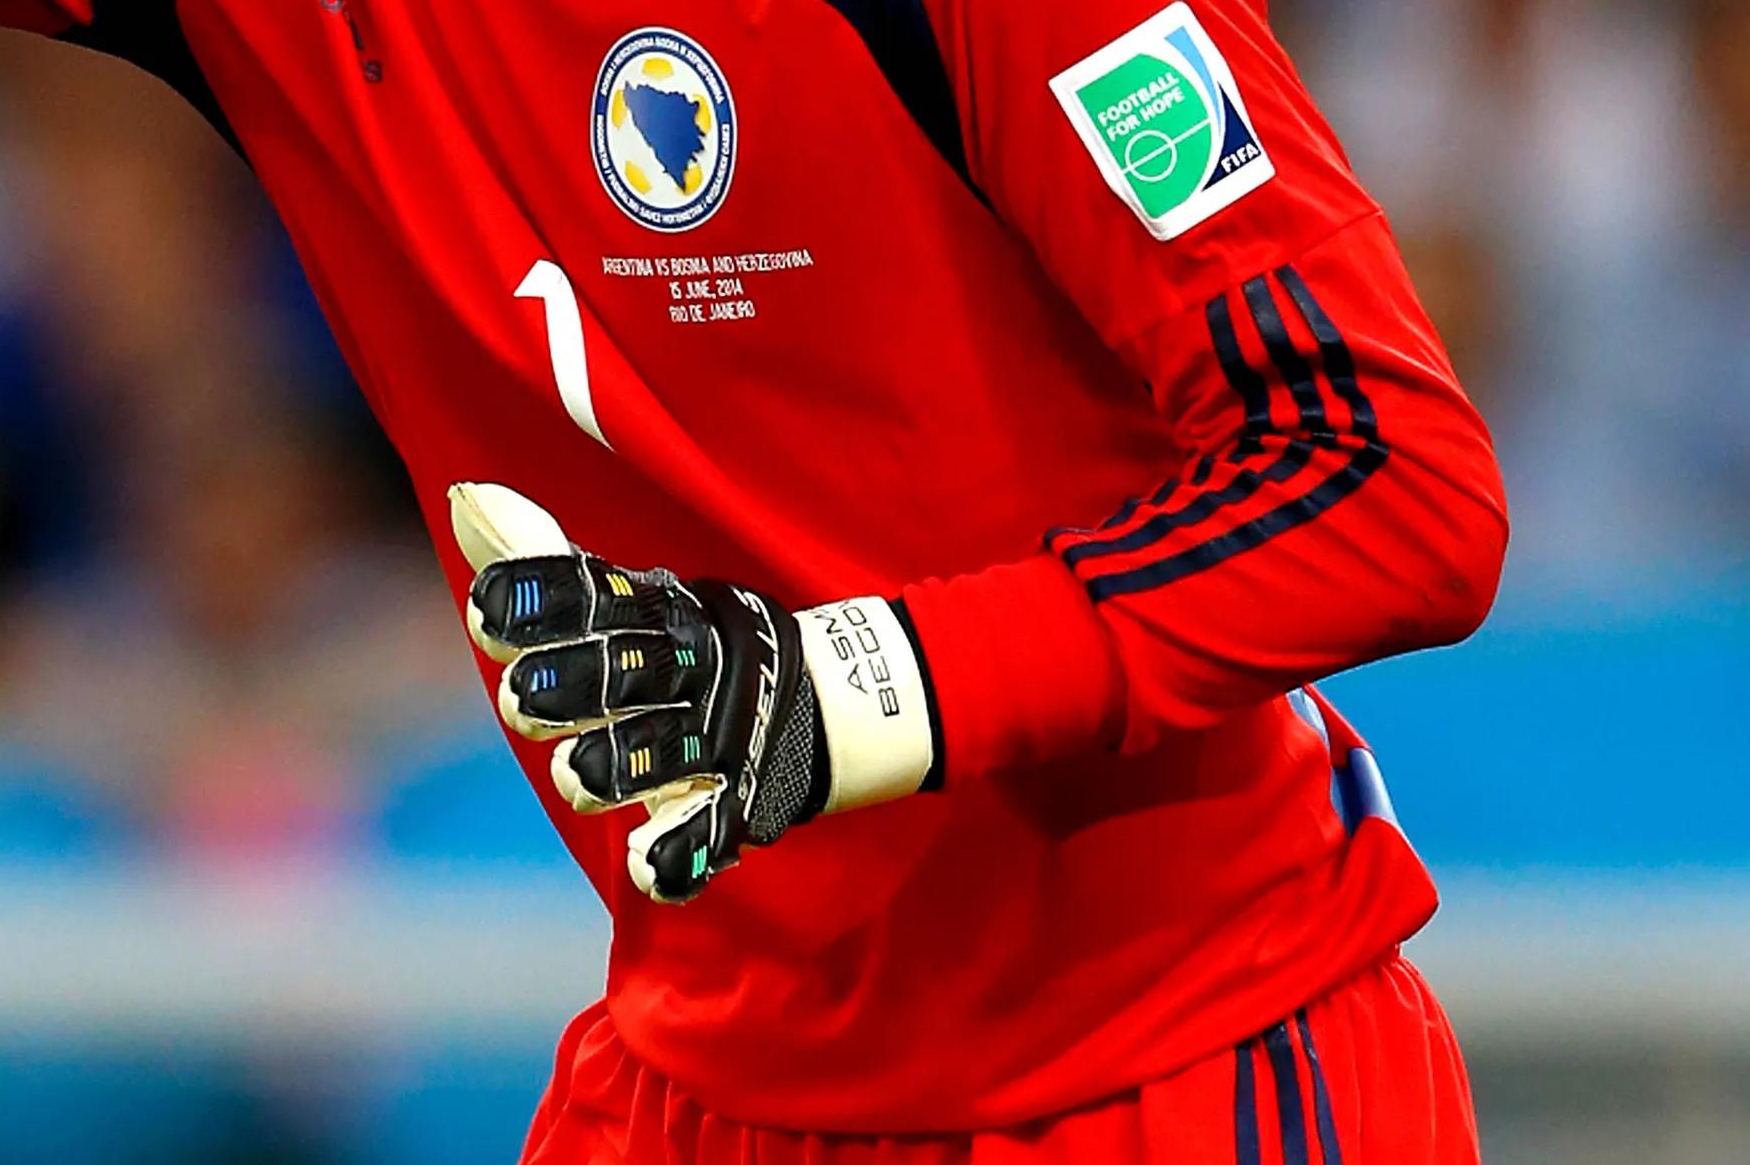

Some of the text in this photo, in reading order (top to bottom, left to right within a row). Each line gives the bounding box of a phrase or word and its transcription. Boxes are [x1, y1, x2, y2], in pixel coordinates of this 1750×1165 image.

[1097, 72, 1180, 127] FOOTBALL
[1107, 86, 1185, 142] FOR HOPE
[1220, 143, 1260, 173] FIFA
[602, 257, 654, 276] ARGENTINA
[670, 257, 711, 276] BOSNIA
[713, 256, 735, 274] AND
[513, 259, 616, 454] 1
